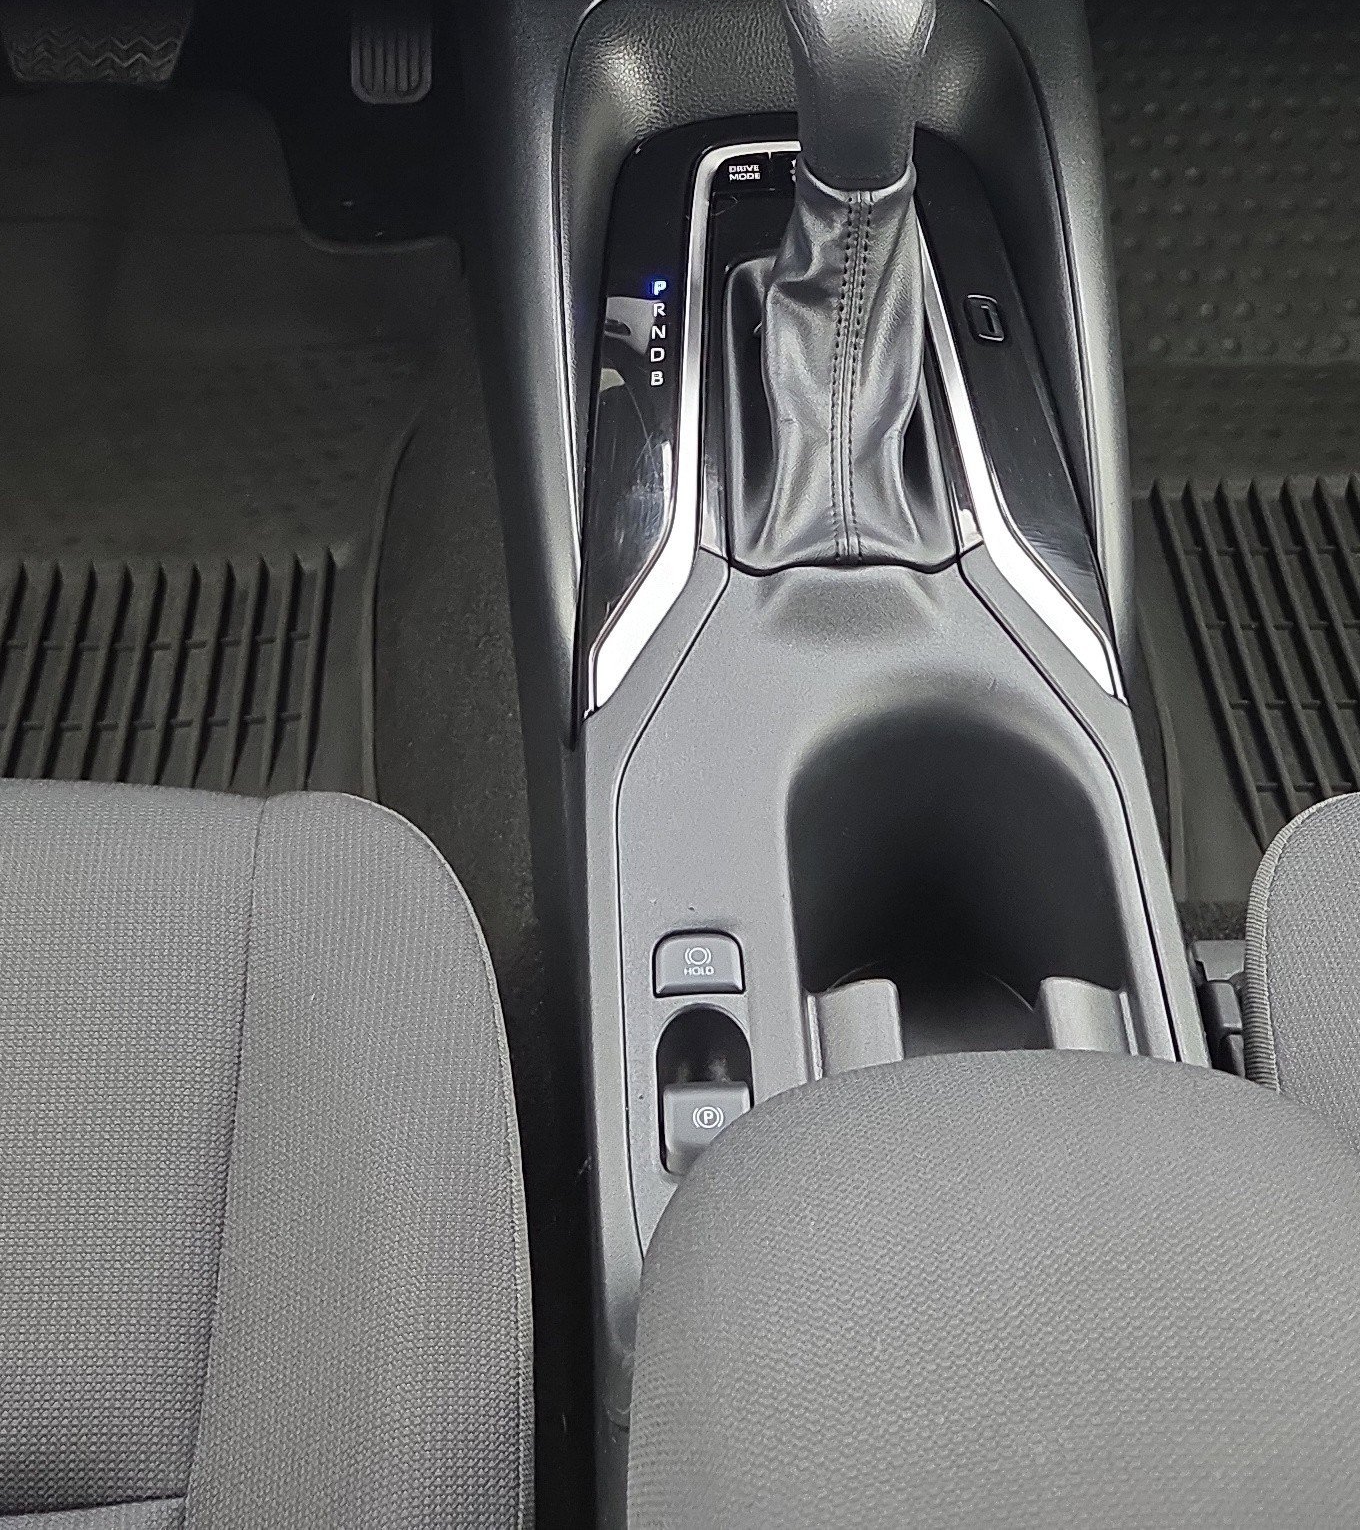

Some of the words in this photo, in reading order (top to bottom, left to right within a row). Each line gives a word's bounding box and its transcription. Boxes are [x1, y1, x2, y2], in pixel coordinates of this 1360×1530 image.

[728, 164, 760, 172] DRIVE
[728, 173, 761, 181] MODE
[652, 280, 667, 296] P
[653, 302, 667, 317] R
[651, 324, 666, 339] N
[650, 346, 665, 362] D
[650, 371, 664, 387] B
[683, 966, 715, 976] HOLD
